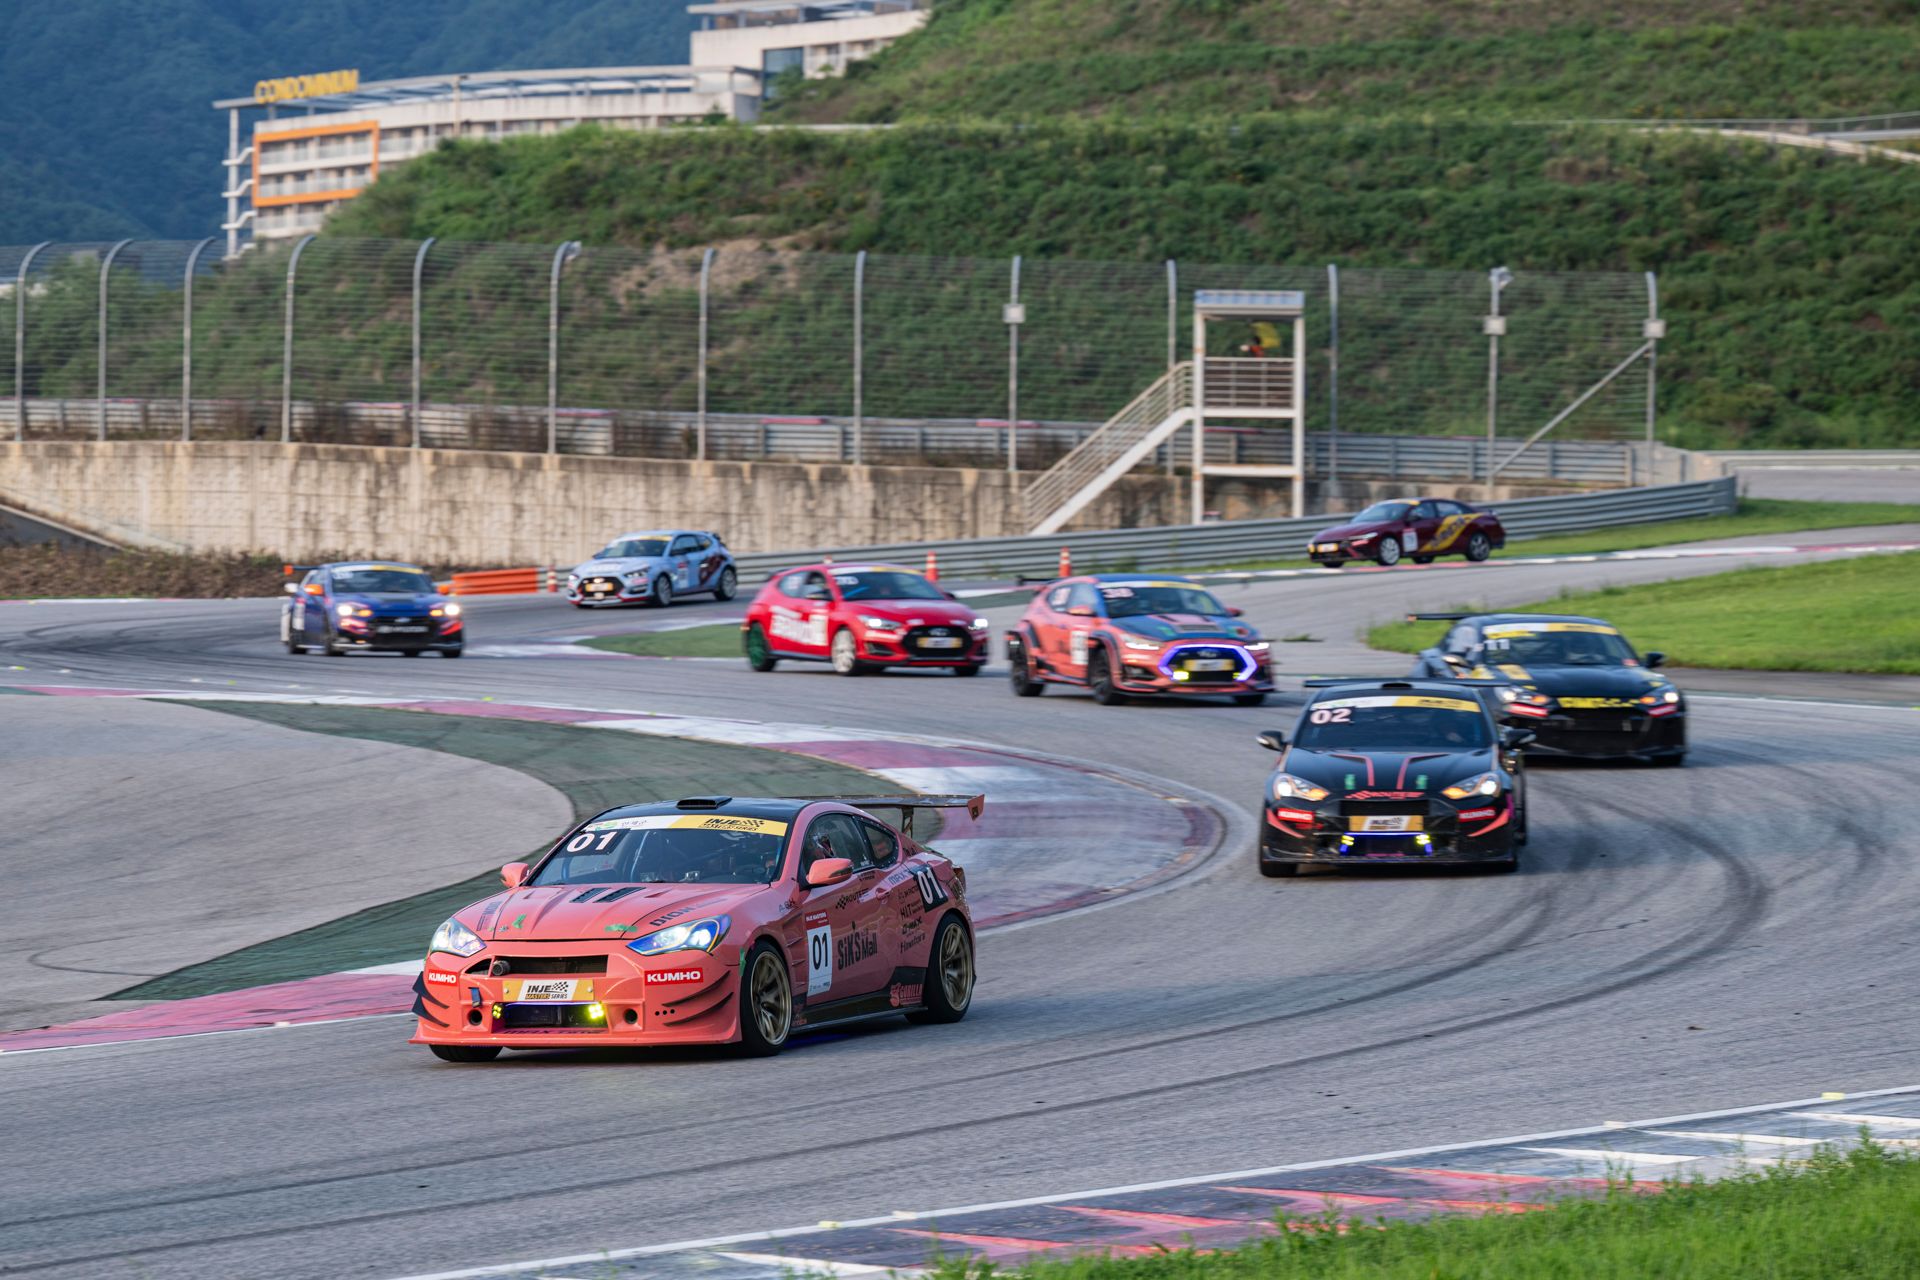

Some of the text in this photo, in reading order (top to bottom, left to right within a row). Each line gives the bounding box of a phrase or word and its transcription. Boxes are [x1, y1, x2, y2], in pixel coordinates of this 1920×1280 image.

[1310, 708, 1352, 724] 02
[566, 831, 618, 853] 01
[917, 866, 943, 904] 01
[812, 932, 829, 971] 01
[428, 972, 457, 984] KUMHO
[647, 970, 701, 983] KUMHO
[527, 985, 551, 993] INJE
